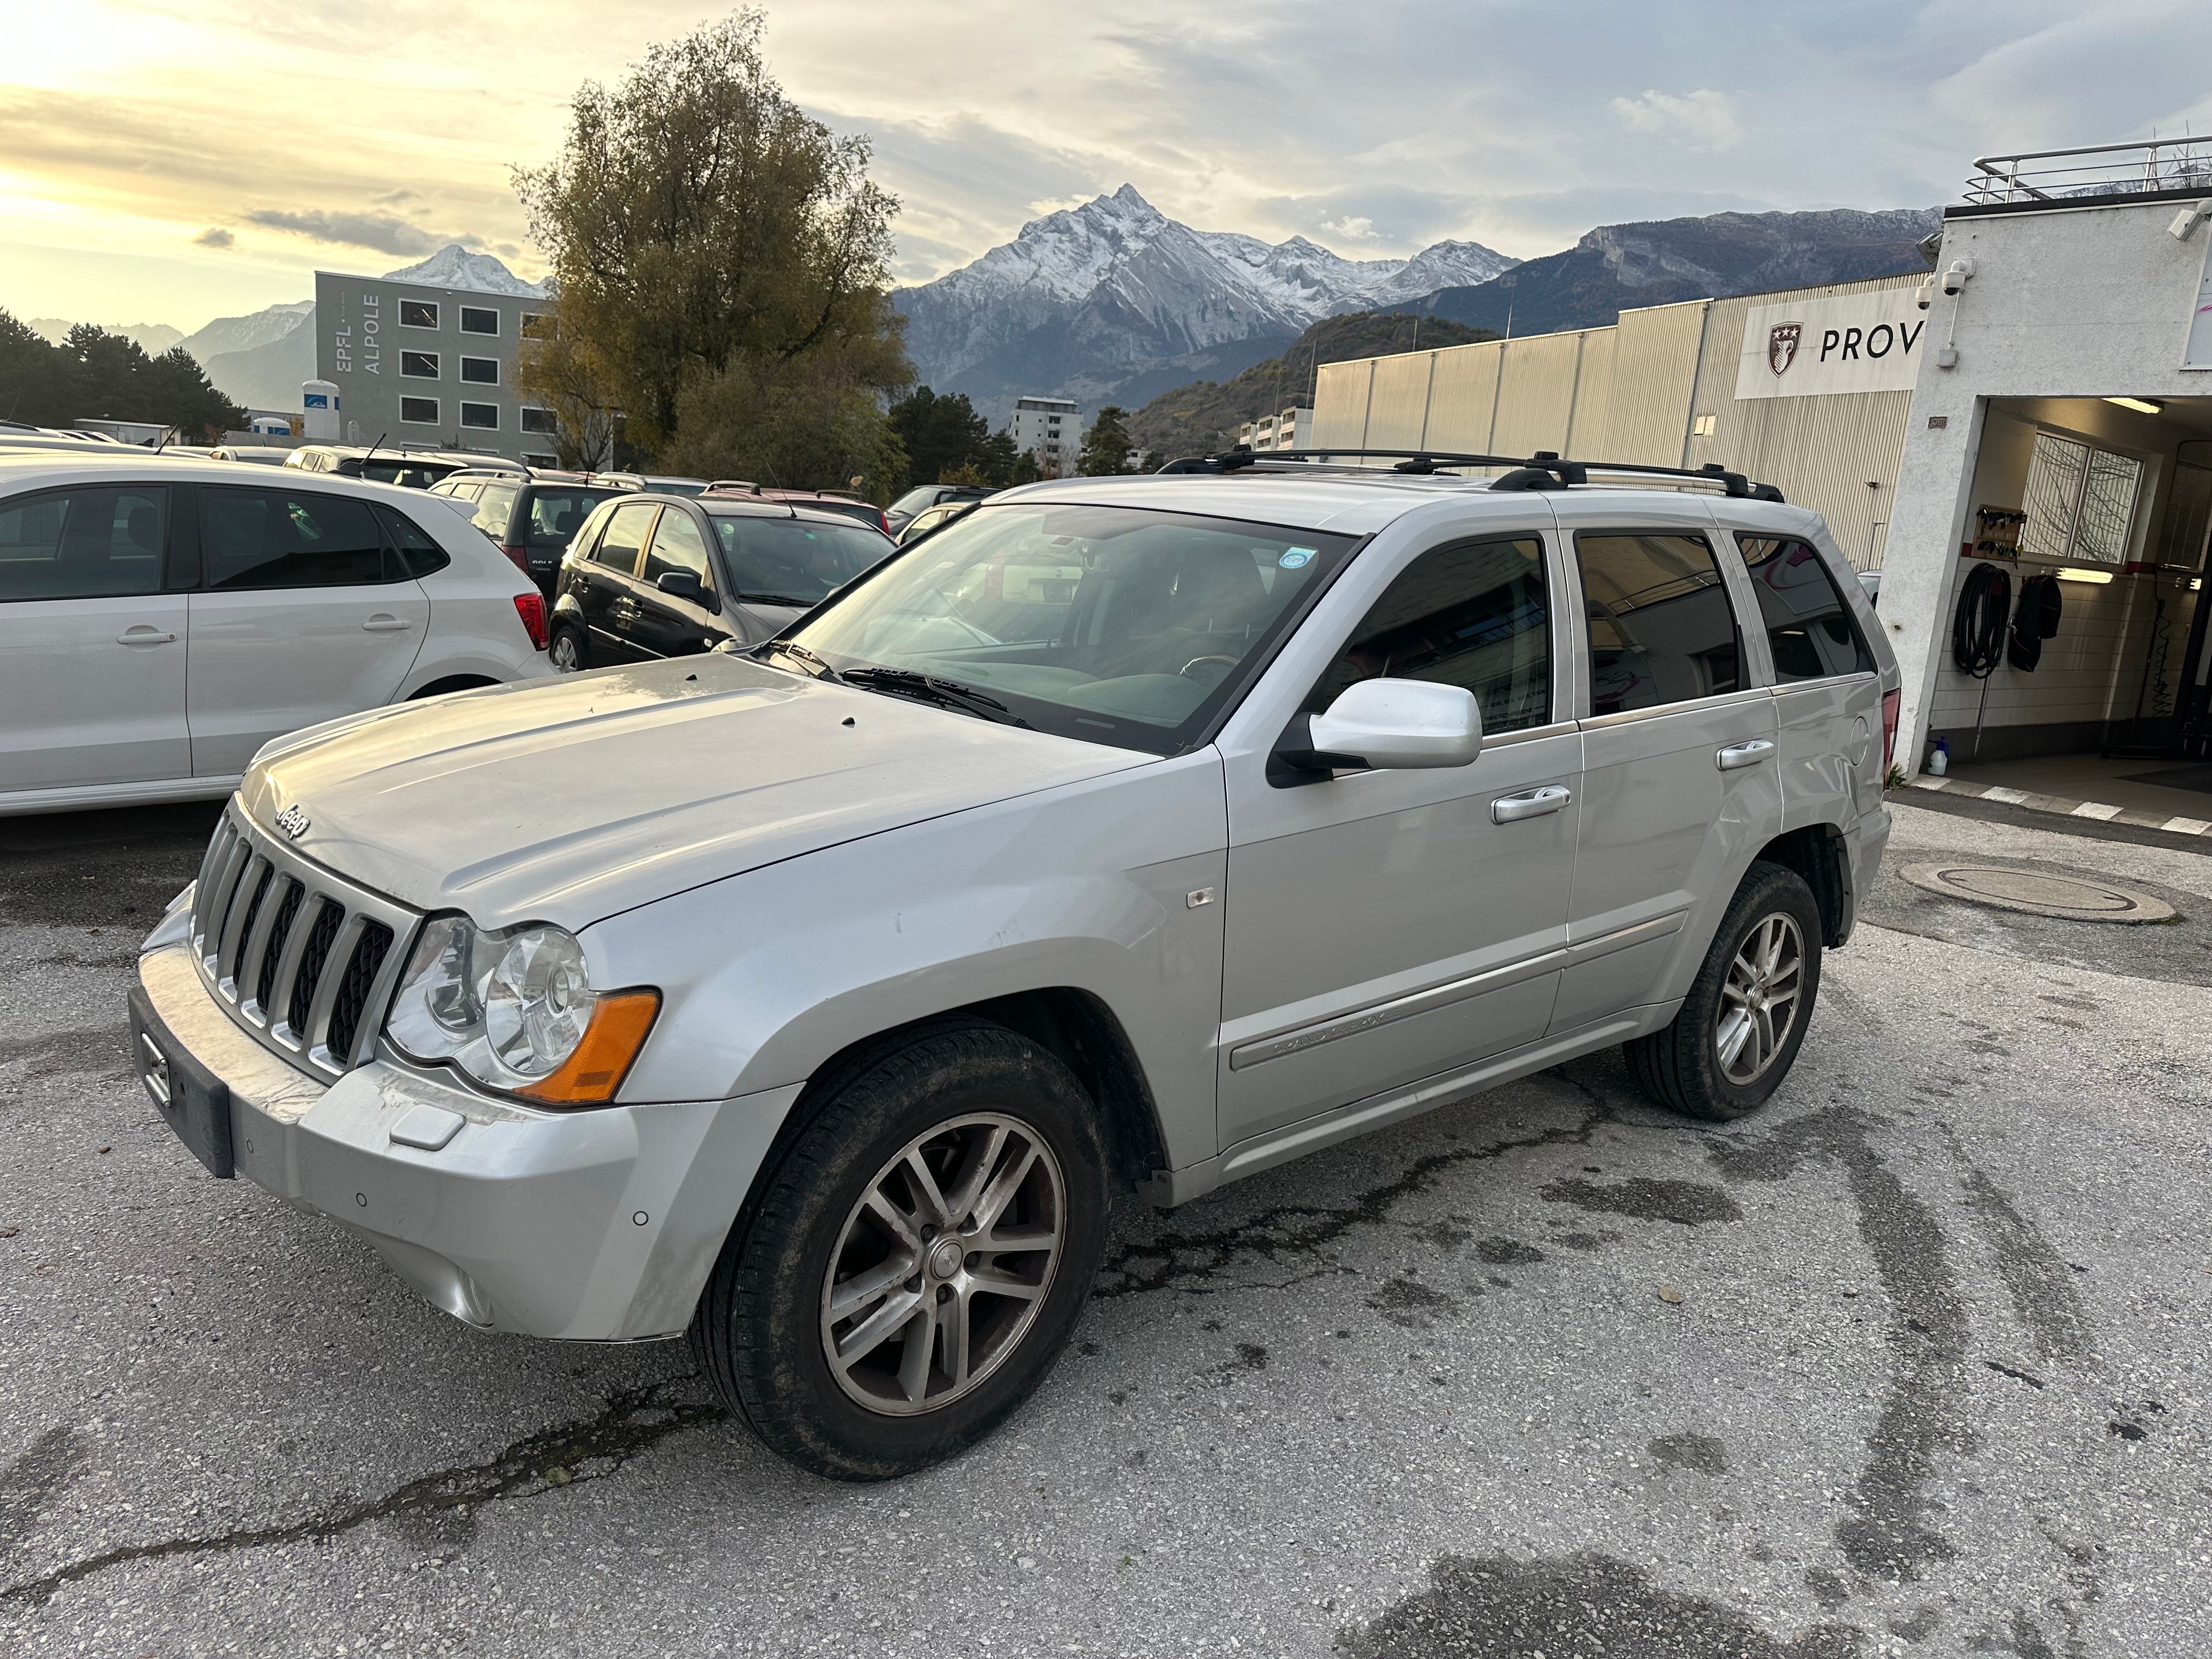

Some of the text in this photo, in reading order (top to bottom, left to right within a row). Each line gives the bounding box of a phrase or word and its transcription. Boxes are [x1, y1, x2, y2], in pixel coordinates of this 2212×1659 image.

[336, 325, 352, 373] EPFL
[363, 294, 380, 375] ALPOLE
[1820, 320, 1925, 363] PROV
[275, 803, 311, 840] Jeep
[1273, 1007, 1403, 1054] GRAND CHEROKEE
